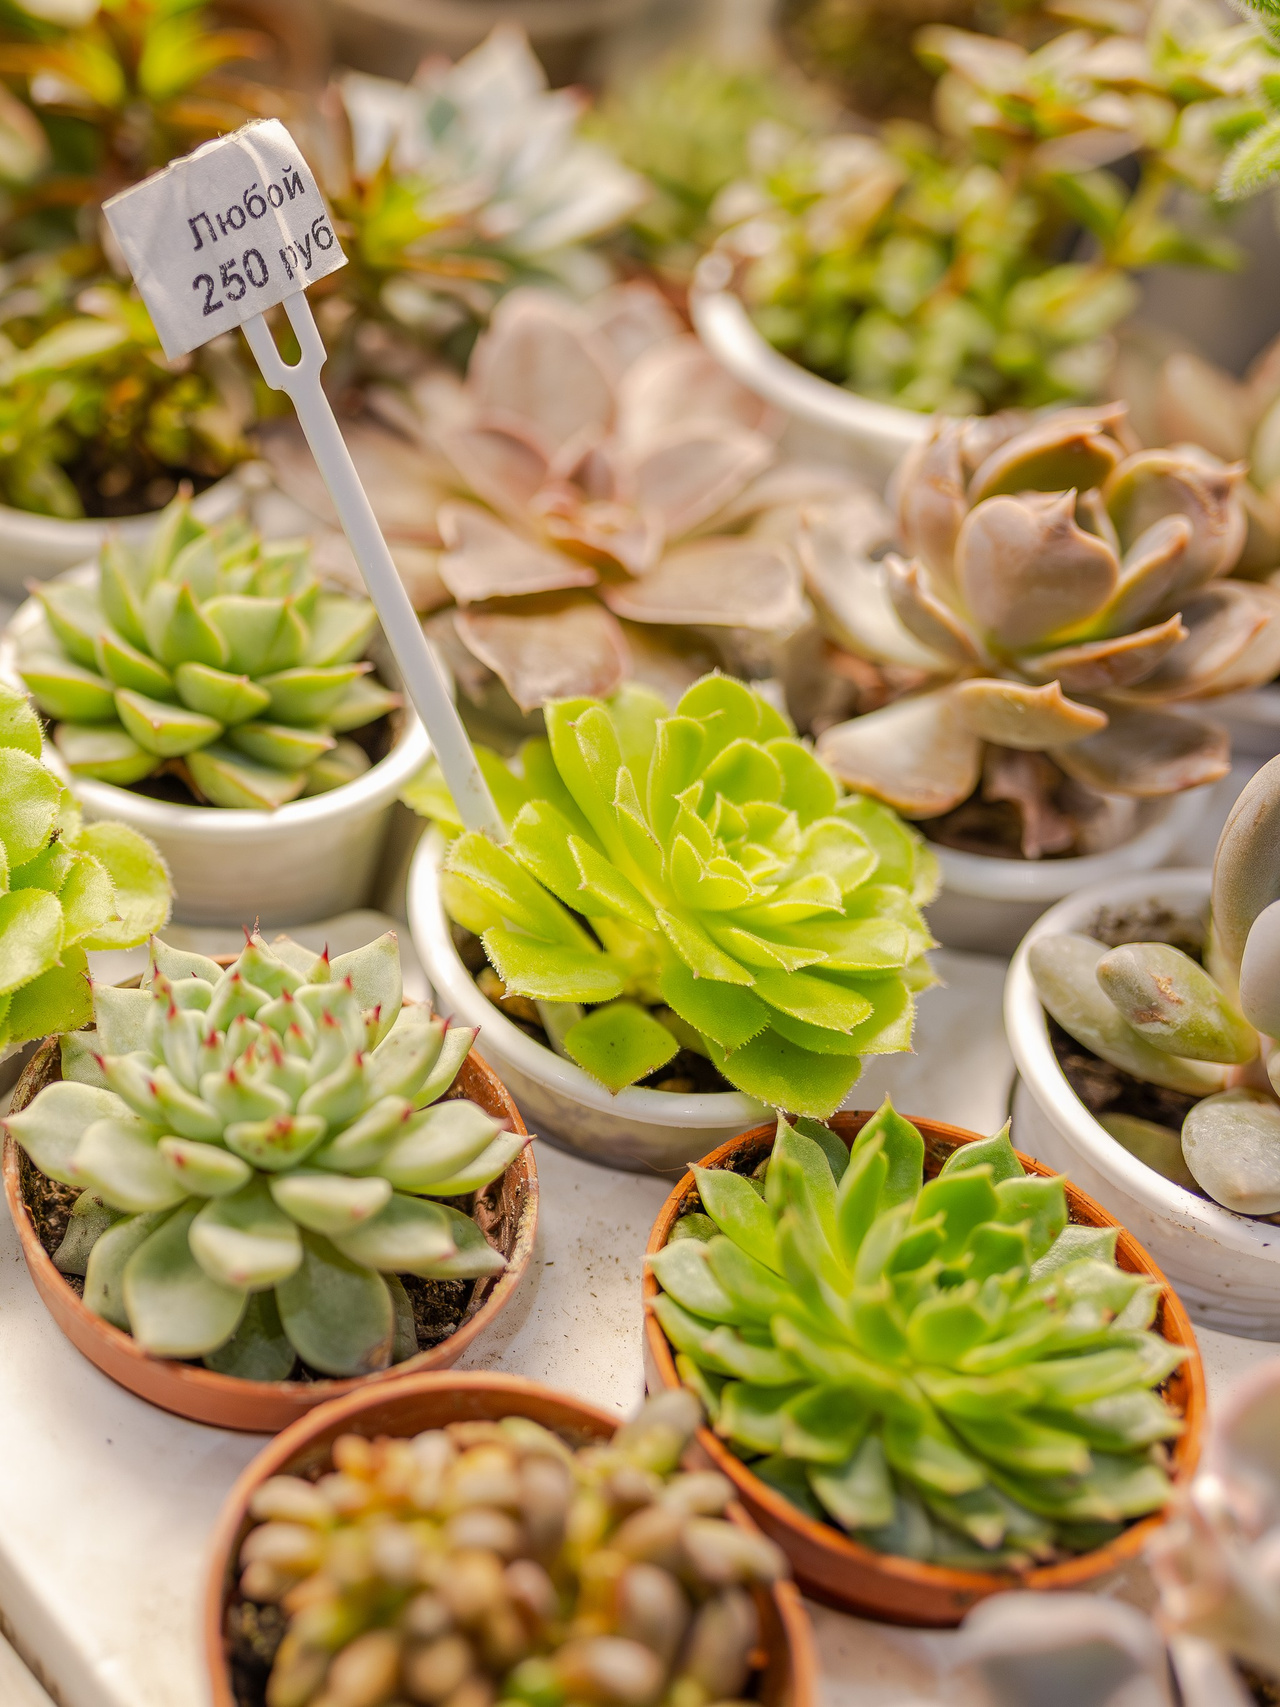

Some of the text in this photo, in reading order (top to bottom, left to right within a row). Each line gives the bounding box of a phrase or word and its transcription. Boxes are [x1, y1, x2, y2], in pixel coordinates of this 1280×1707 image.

[187, 165, 305, 252] Любой
[192, 214, 334, 317] 250 руб
